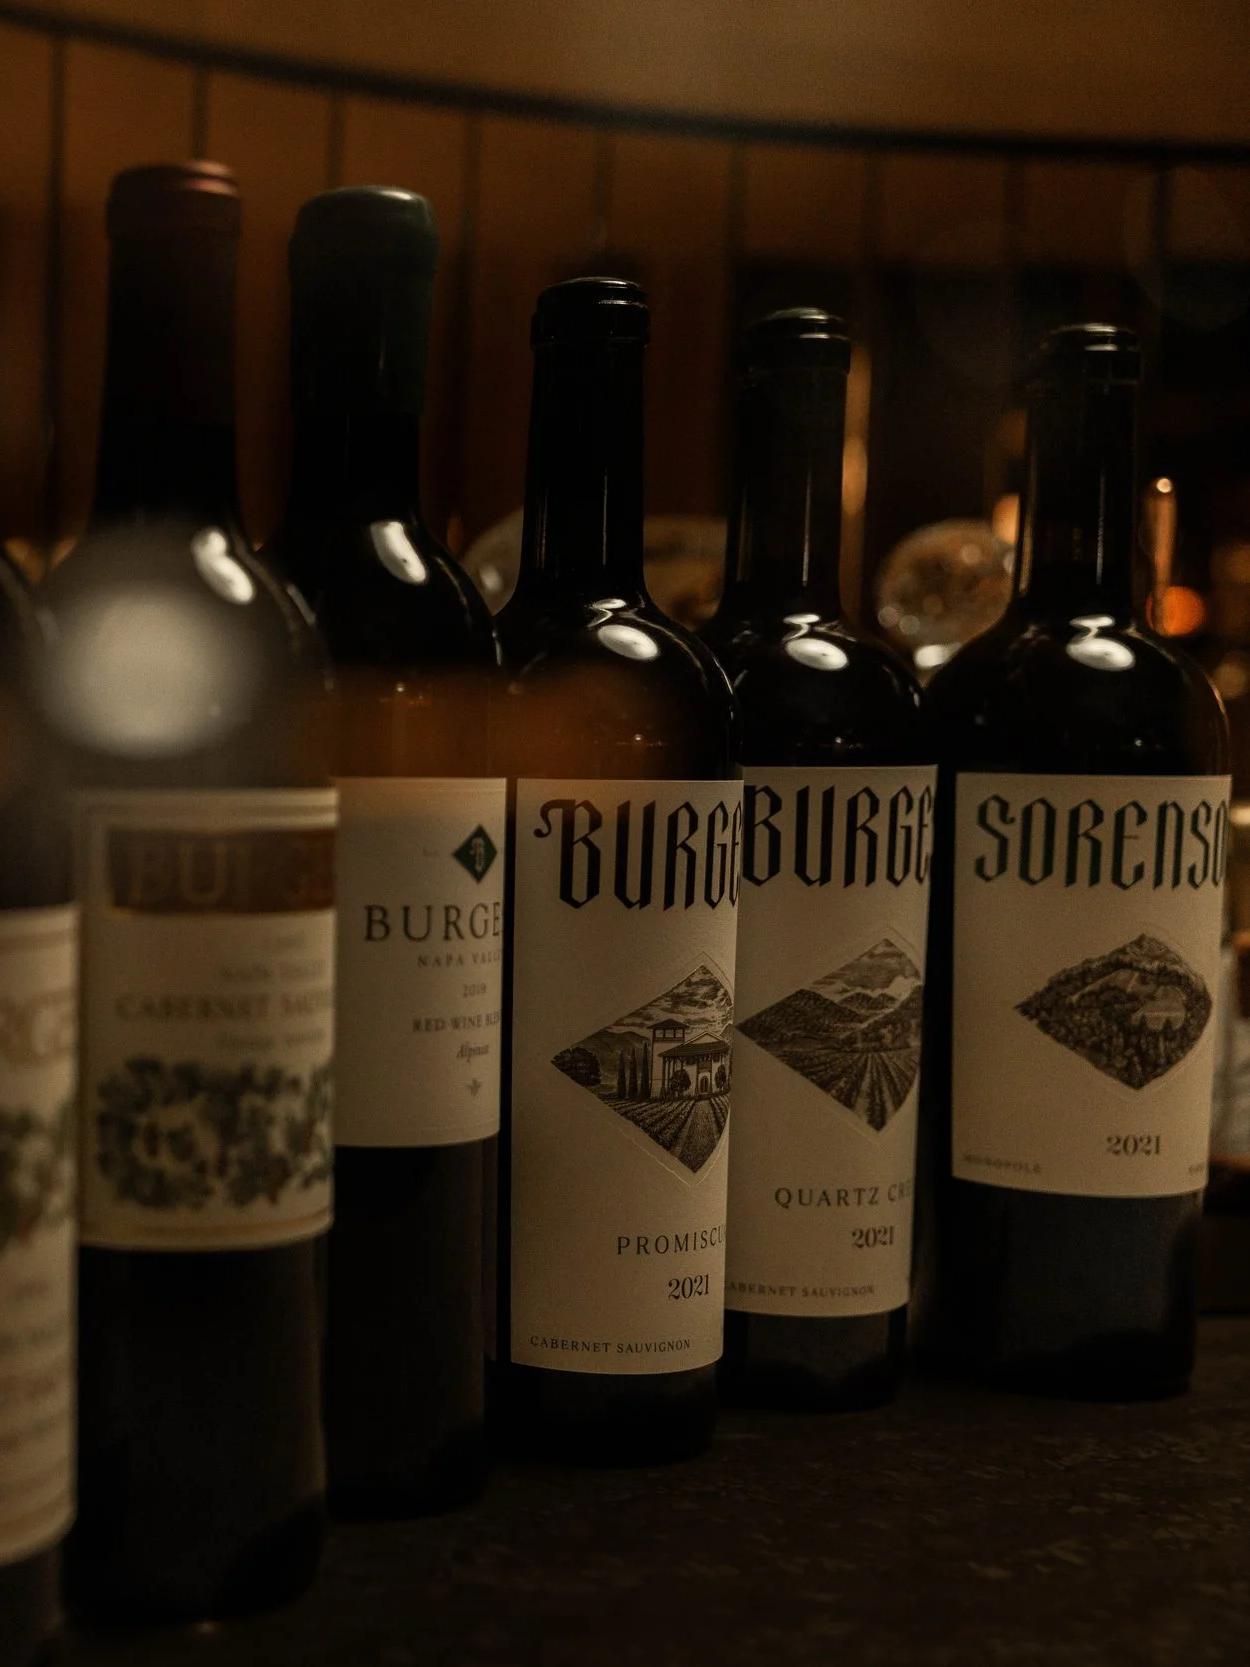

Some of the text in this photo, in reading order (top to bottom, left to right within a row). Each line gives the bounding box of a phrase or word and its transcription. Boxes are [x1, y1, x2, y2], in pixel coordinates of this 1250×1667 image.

[742, 784, 932, 888] BURGE
[533, 799, 743, 911] BURGE
[364, 901, 500, 942] BURGE
[1106, 1134, 1162, 1157] 2021
[774, 1186, 880, 1209] QUARTZ
[851, 1226, 895, 1249] 2021
[668, 1274, 710, 1300] 2021
[726, 1281, 876, 1299] ABERNET SAUVIGNON
[529, 1335, 691, 1354] CABERNET SAUVIGNON
